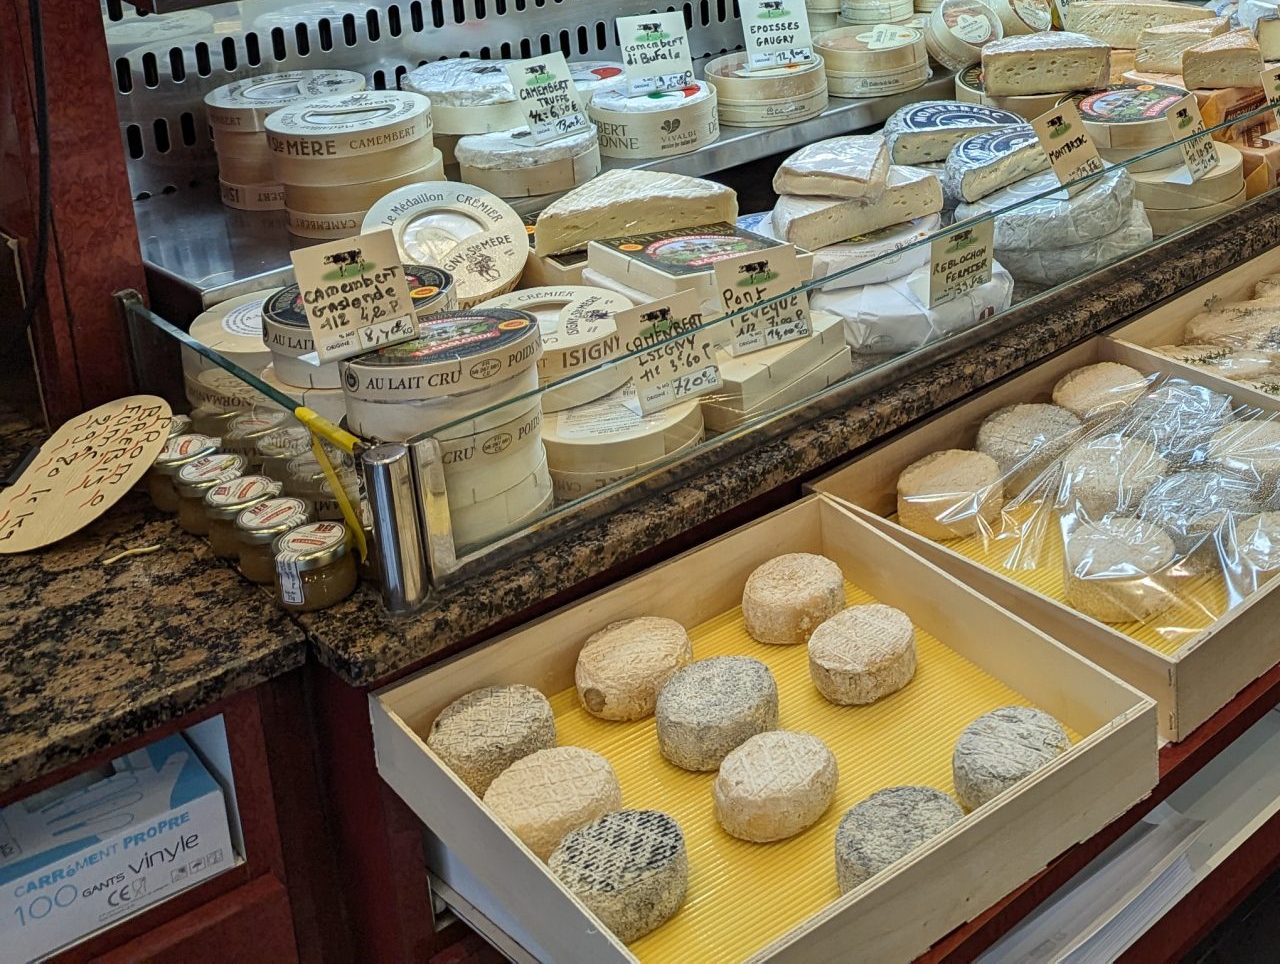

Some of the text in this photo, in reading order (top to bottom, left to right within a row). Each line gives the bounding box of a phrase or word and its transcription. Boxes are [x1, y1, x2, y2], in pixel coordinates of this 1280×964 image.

[750, 21, 800, 34] EPOISSES
[756, 35, 794, 46] GAUGRY
[287, 139, 337, 156] MÈRE
[349, 125, 416, 150] CAMEMBERT
[661, 130, 697, 143] VIVALDI
[391, 190, 445, 217] Médaillon
[455, 191, 504, 224] CRÉMIER
[932, 245, 987, 275] REBLOCHON
[945, 258, 988, 283] FERMIER
[722, 287, 768, 309] Pont
[273, 334, 288, 345] AU
[508, 345, 535, 367] POIDS
[561, 335, 622, 369] ISIGNY
[365, 370, 461, 390] AU LAIT CRU
[122, 811, 191, 850] PROPRE
[13, 883, 78, 926] 100
[82, 872, 125, 898] GANTS
[128, 833, 200, 874] vinyle
